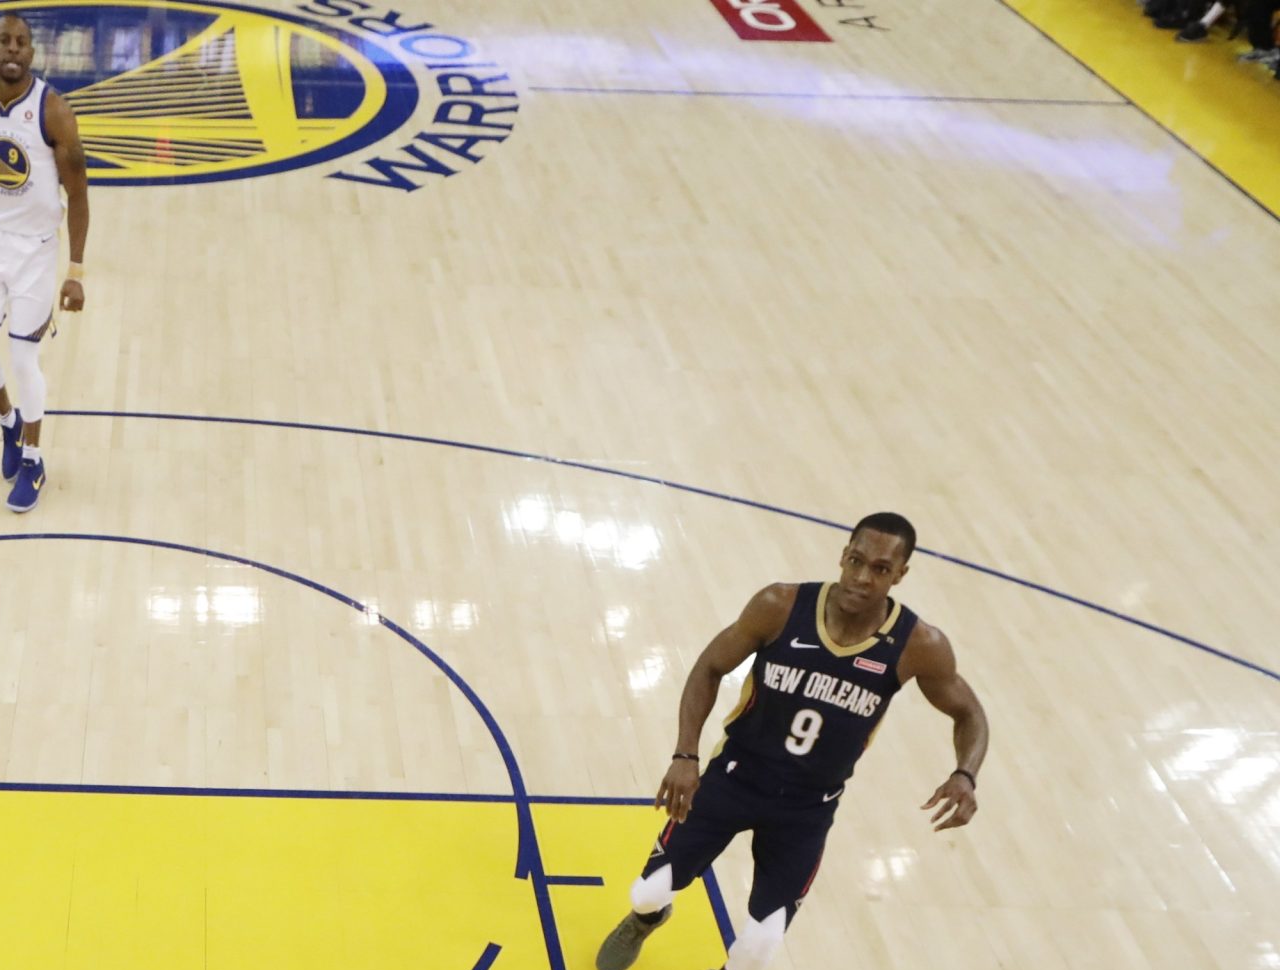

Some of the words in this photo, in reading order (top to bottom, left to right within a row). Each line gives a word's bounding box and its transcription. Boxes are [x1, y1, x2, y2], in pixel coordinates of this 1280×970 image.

[8, 147, 19, 165] 9
[763, 661, 806, 695] NEW
[803, 671, 882, 717] ORLEANS
[784, 708, 823, 756] 9
